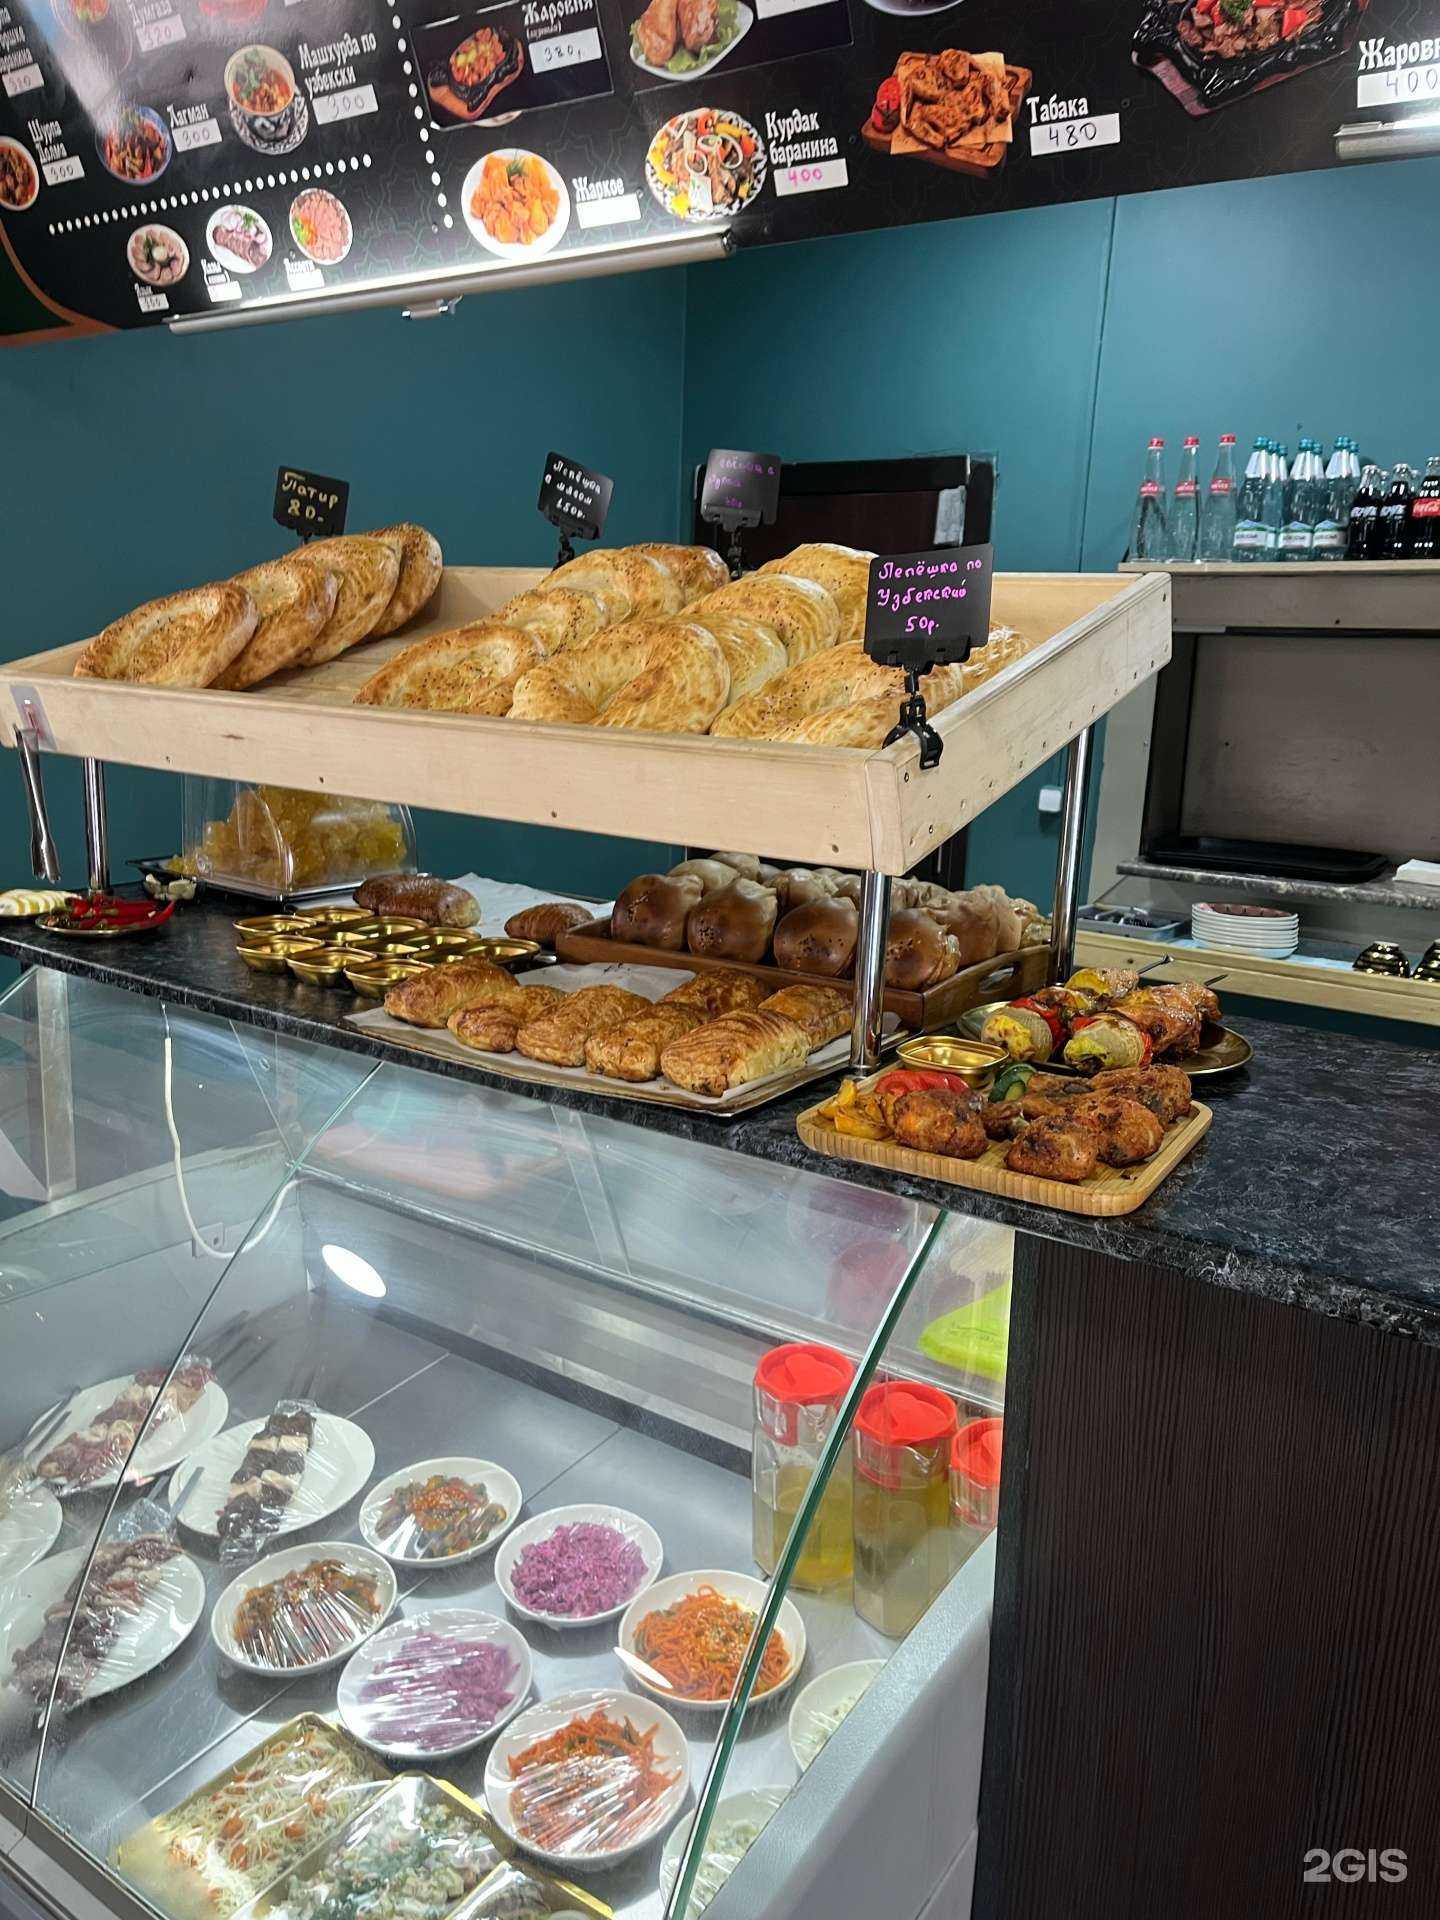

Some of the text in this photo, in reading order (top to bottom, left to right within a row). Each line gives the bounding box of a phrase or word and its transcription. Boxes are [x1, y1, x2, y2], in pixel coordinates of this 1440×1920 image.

[361, 32, 377, 54] по
[304, 66, 357, 100] узбекски
[1386, 69, 1438, 97] 400
[166, 104, 210, 129] Лагман
[1026, 93, 1089, 124] Табака
[765, 108, 820, 143] Курдак
[1048, 123, 1097, 147] 480
[769, 136, 839, 168] баранина
[572, 176, 625, 202] Жаркое
[788, 168, 822, 187] 400
[966, 559, 983, 571] по
